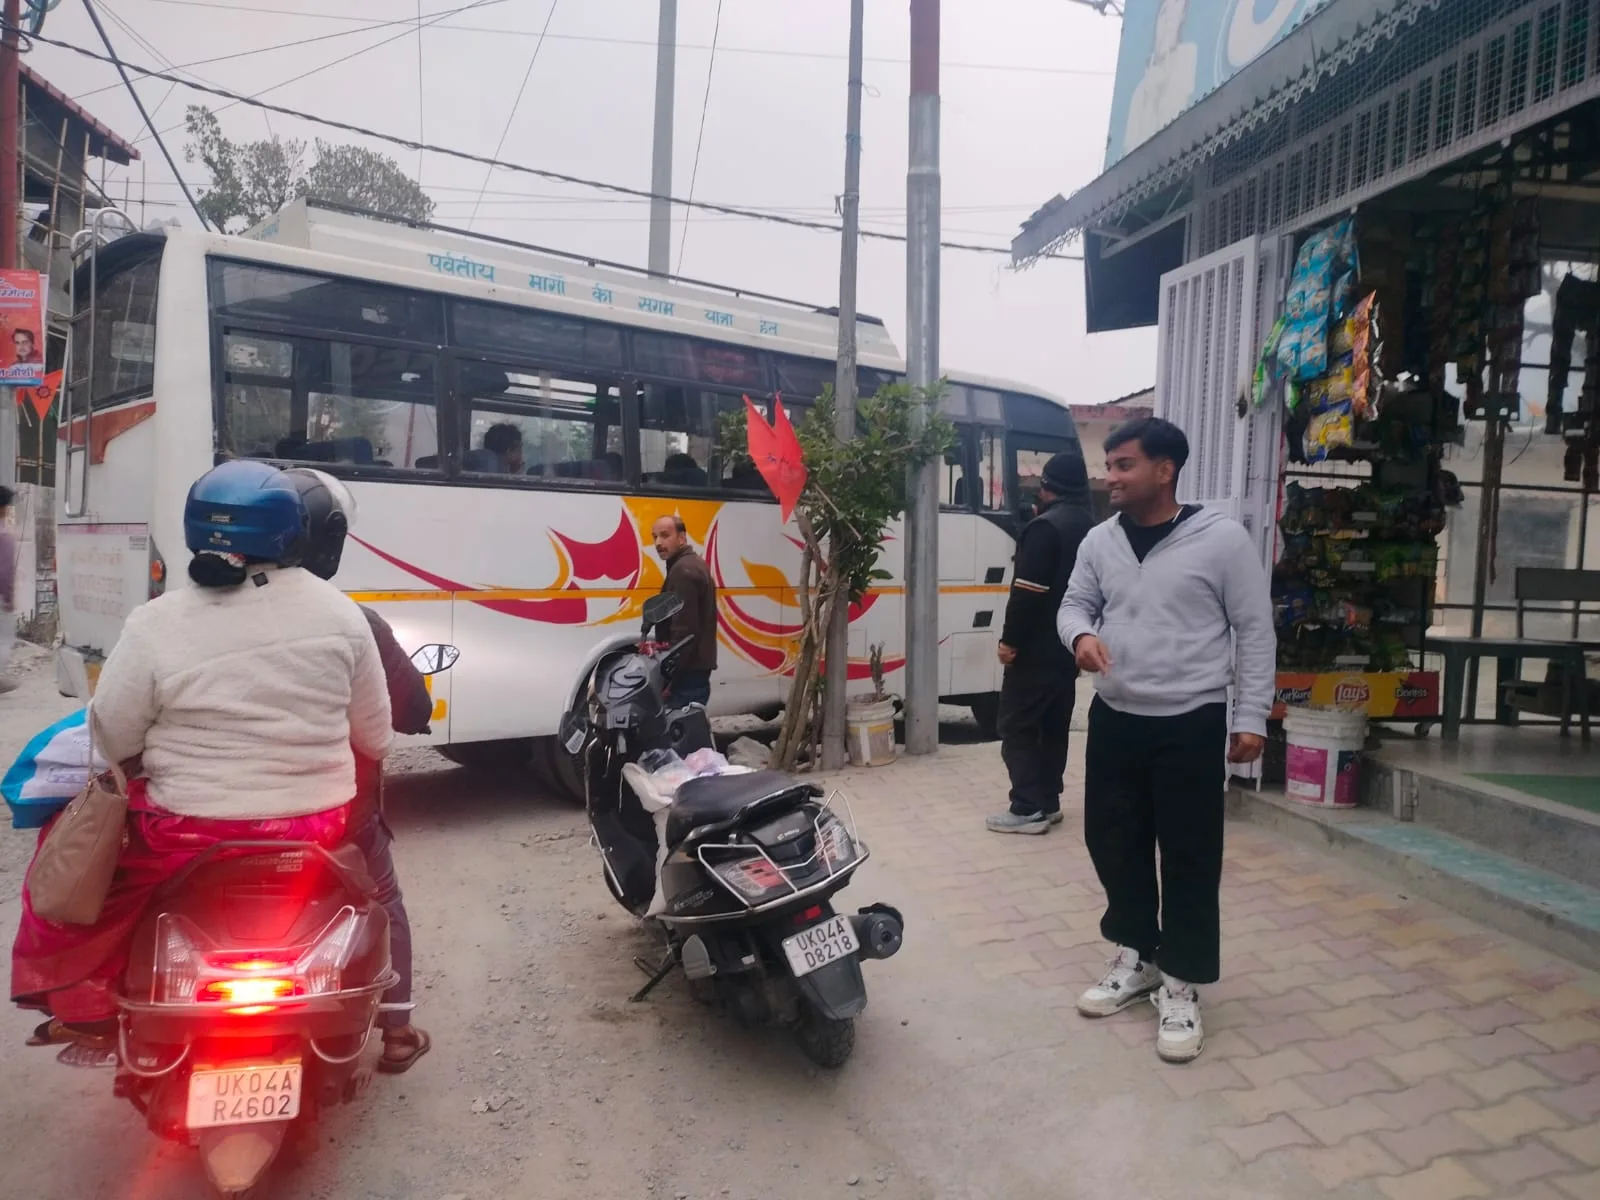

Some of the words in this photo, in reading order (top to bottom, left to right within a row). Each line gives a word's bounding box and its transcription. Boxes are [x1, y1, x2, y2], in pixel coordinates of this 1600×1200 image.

[796, 919, 845, 951] UK04A
[804, 935, 852, 968] D8218
[216, 1070, 293, 1097] UK04A
[213, 1094, 291, 1121] R4602
